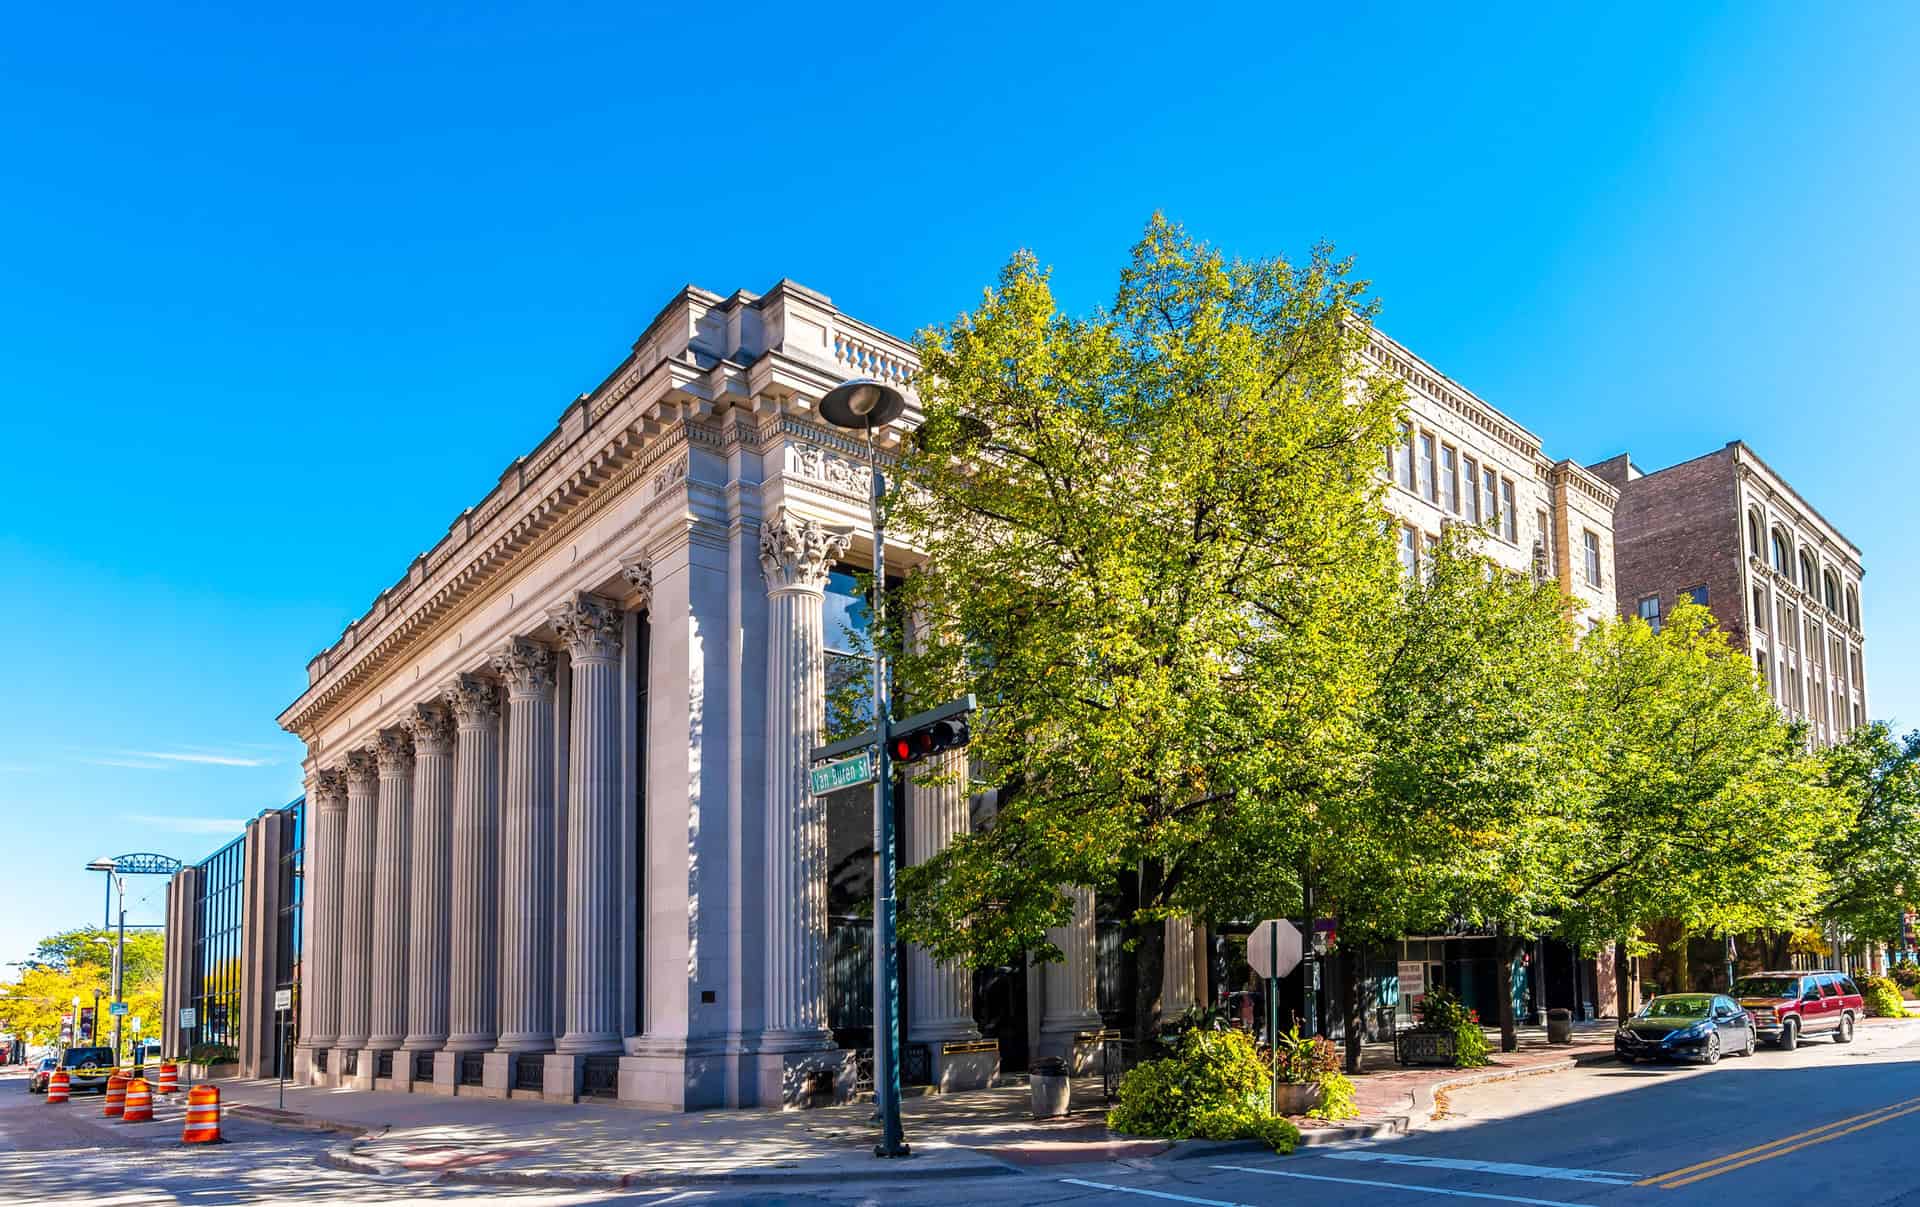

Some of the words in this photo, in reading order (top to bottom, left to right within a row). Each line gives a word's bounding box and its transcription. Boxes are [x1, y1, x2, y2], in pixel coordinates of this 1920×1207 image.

[814, 772, 830, 791] Van
[832, 766, 856, 785] Buren
[858, 758, 868, 778] St
